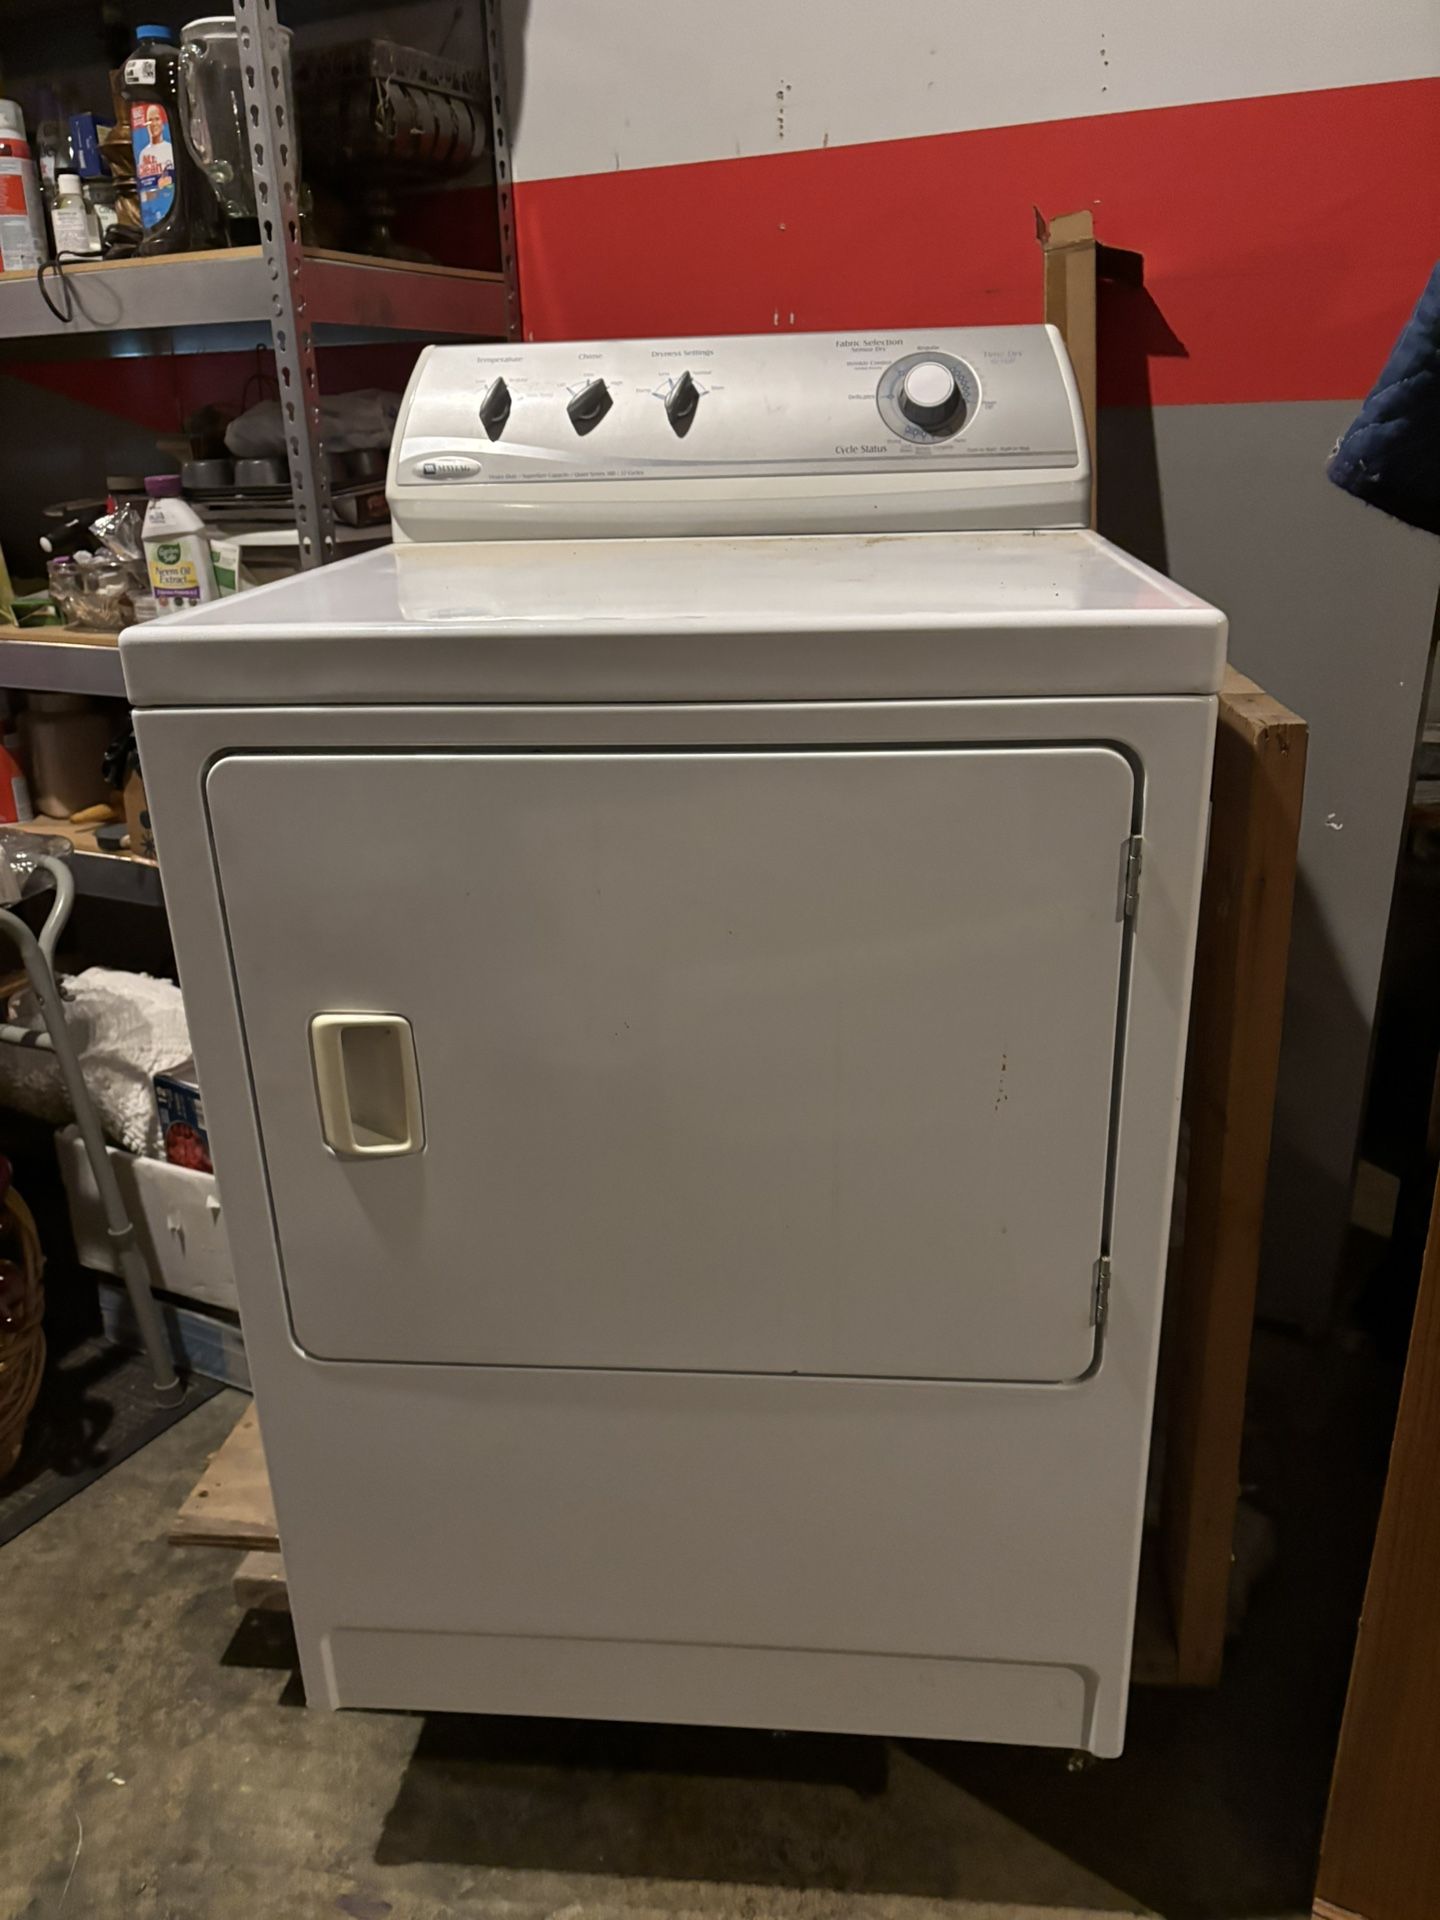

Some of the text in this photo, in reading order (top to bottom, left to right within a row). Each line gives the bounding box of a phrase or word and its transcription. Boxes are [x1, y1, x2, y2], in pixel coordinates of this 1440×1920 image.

[835, 338, 904, 348] Fabric Selection
[651, 349, 715, 358] Dryness Settings
[477, 356, 524, 364] Temperature
[834, 445, 859, 455] Cycle
[860, 443, 888, 454] Status
[155, 565, 191, 576] Neem Oil
[159, 575, 187, 585] Extract
